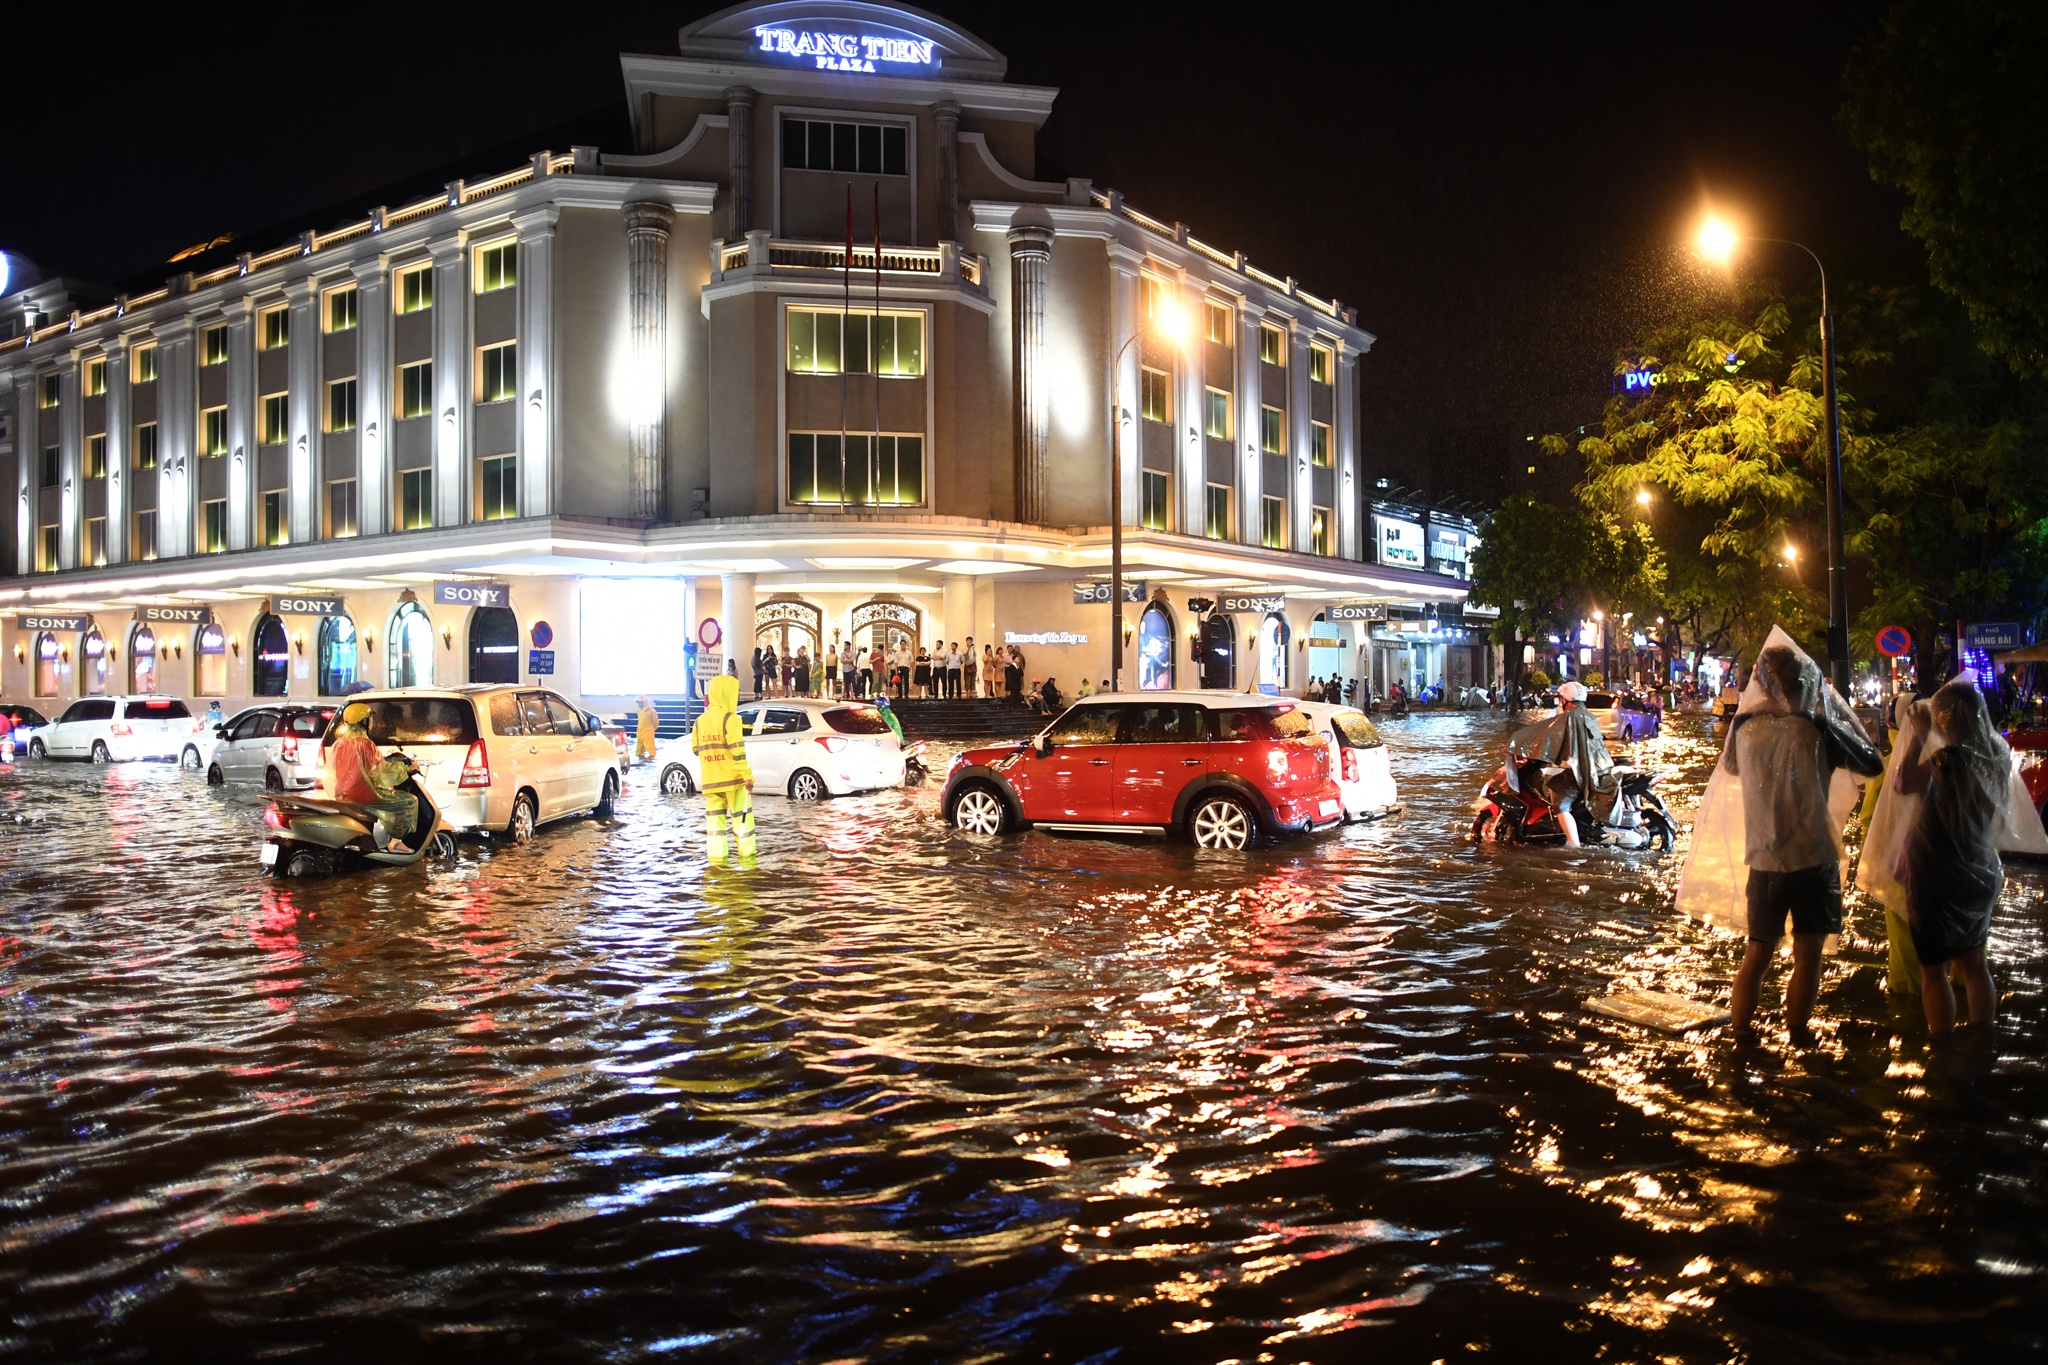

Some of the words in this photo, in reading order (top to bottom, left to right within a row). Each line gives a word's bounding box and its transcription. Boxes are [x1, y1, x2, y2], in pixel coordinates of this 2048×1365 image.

[756, 28, 858, 57] TRANG
[861, 36, 934, 64] TIEN
[815, 56, 876, 73] PLAZA
[1386, 546, 1418, 562] HOTEL
[444, 586, 500, 602] SONY
[1082, 587, 1138, 600] SOY
[279, 599, 336, 613] SONY
[1225, 597, 1277, 610] SONY
[147, 608, 203, 620] SONY
[1332, 607, 1379, 618] SONY
[26, 618, 79, 629] SONY
[1974, 634, 1996, 645] HÀNG
[703, 754, 726, 762] POLICE
